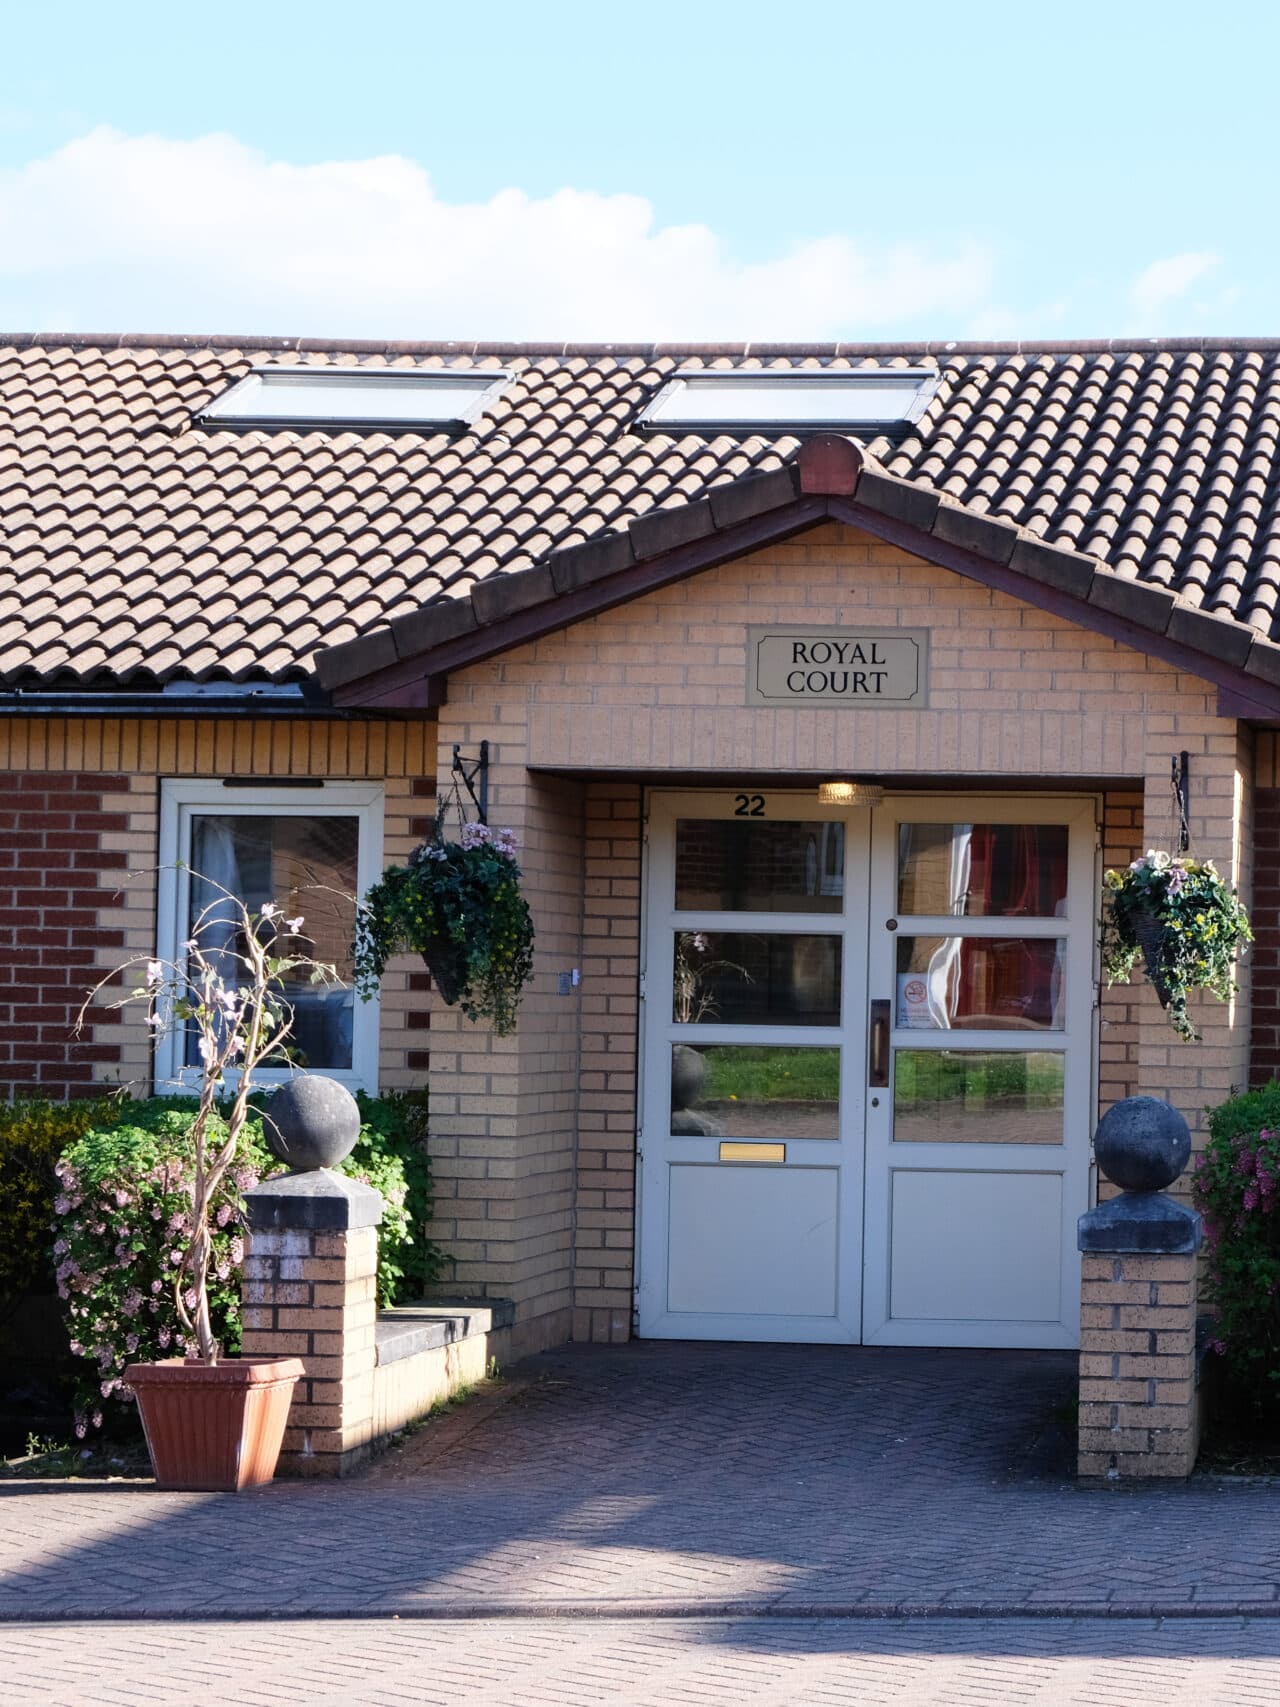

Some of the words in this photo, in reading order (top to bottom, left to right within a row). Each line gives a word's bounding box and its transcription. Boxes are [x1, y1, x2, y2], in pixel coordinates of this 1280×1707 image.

[792, 642, 886, 664] ROYAL
[787, 671, 888, 693] COURT
[734, 794, 766, 816] 22
